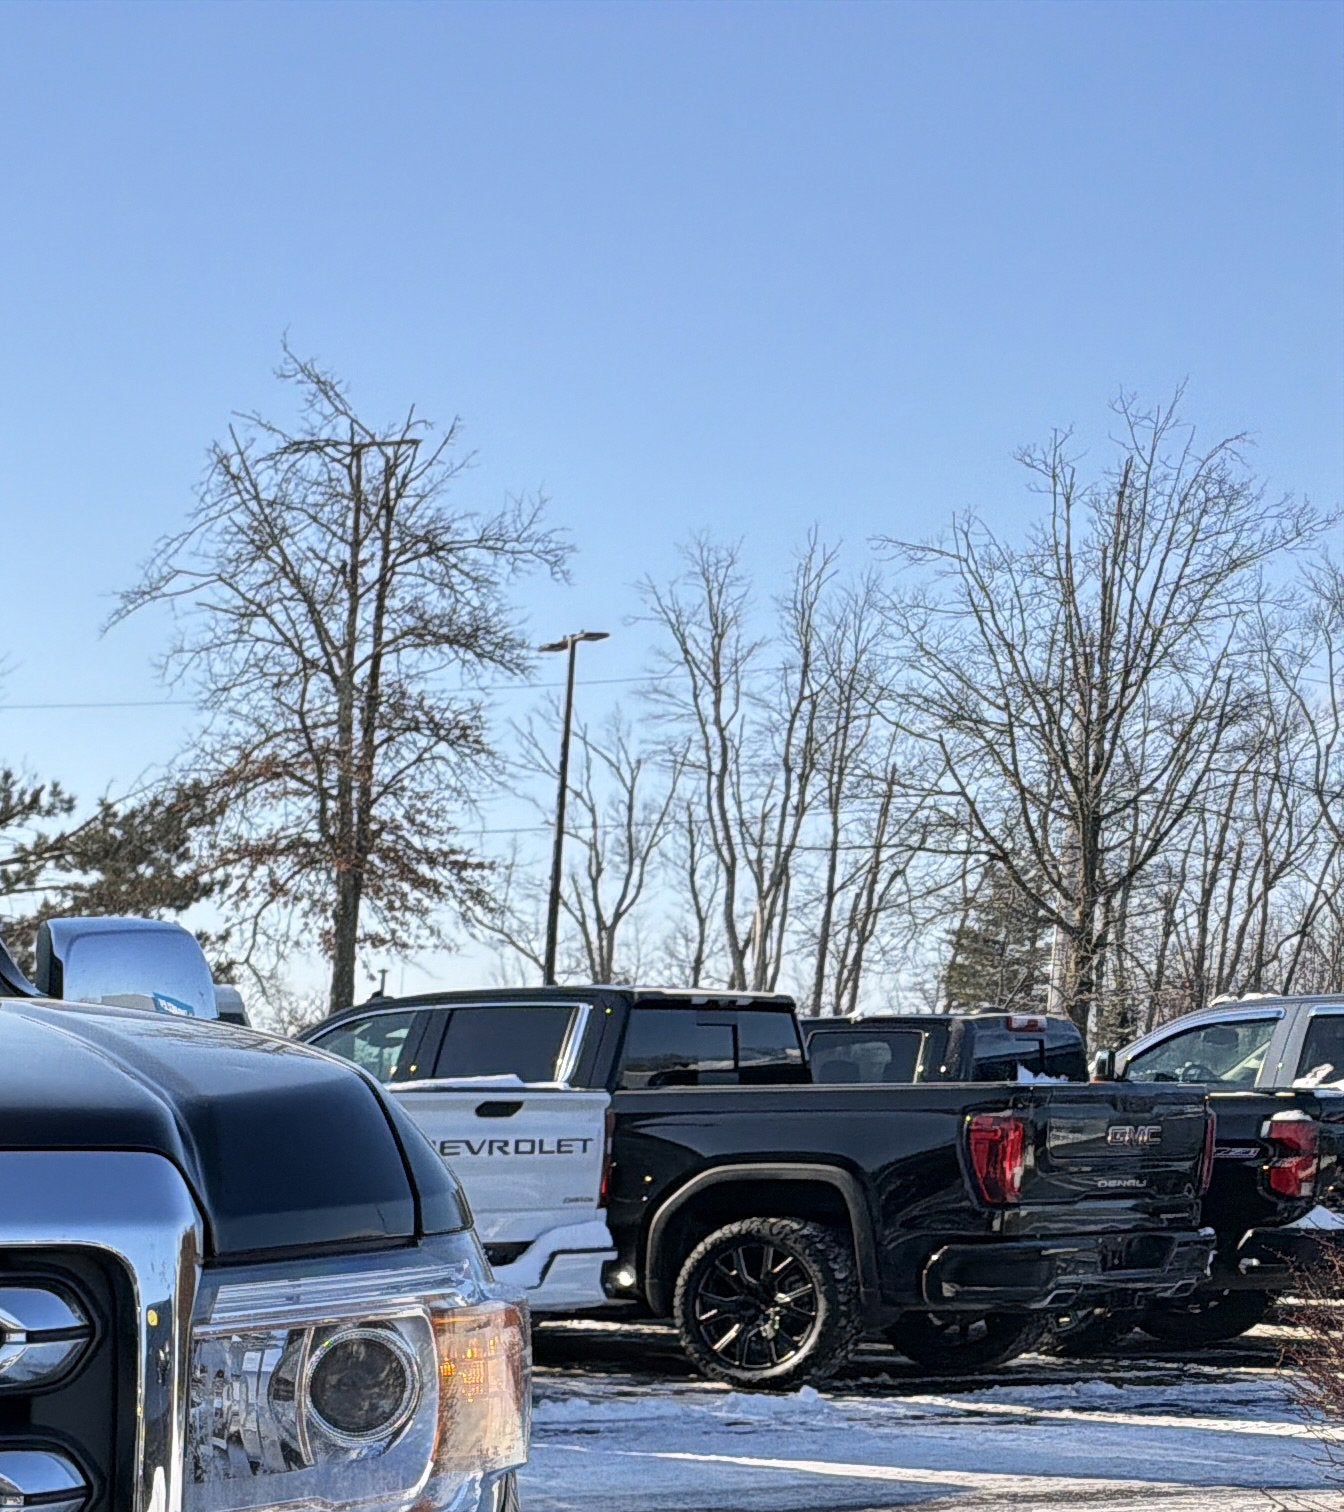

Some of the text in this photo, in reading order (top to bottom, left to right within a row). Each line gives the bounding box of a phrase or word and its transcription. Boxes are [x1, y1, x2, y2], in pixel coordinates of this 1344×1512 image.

[1107, 1126, 1161, 1146] GMC
[431, 1138, 594, 1156] EVROLET
[1097, 1179, 1147, 1188] DENALI
